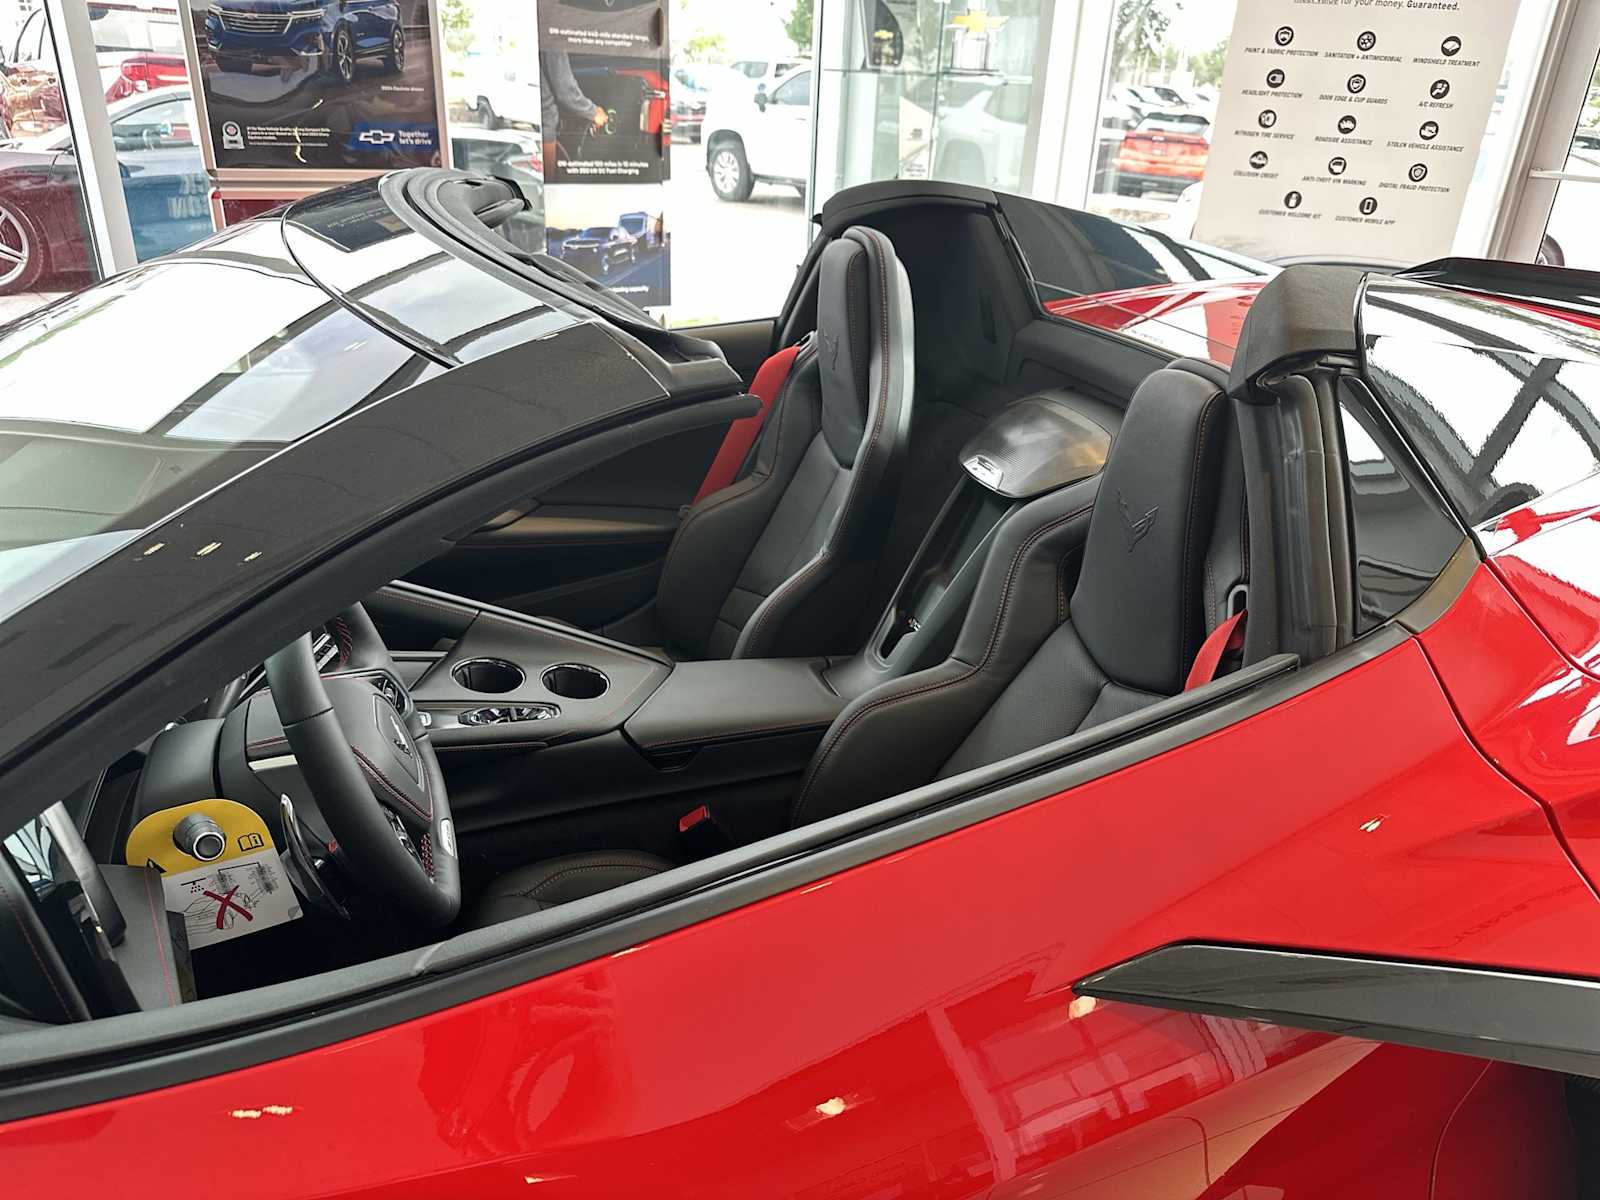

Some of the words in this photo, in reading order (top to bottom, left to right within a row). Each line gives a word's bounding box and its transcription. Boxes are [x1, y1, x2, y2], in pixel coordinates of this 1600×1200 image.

[1406, 0, 1460, 11] Guaranteed.
[1286, 49, 1319, 57] PROTECTION
[1324, 51, 1355, 59] SANITATION
[1361, 54, 1403, 63] ANTIMICROBIAL
[1448, 59, 1480, 67] TREATMENT
[1241, 89, 1269, 97] HEADLIGHT
[398, 129, 429, 139] Together
[1273, 132, 1295, 140] SERVICE
[1340, 137, 1374, 145] ASSISTANCE
[1408, 142, 1430, 150] VEHICLE
[1430, 144, 1464, 152] ASSISTANCE
[1233, 170, 1259, 178] COLLISION
[1260, 171, 1279, 179] CREDIT
[1417, 185, 1450, 193] PROTECTION
[1259, 208, 1286, 217] CUSTOMER
[1287, 211, 1312, 219] WELCOME
[1335, 215, 1363, 223] CUSTOMER
